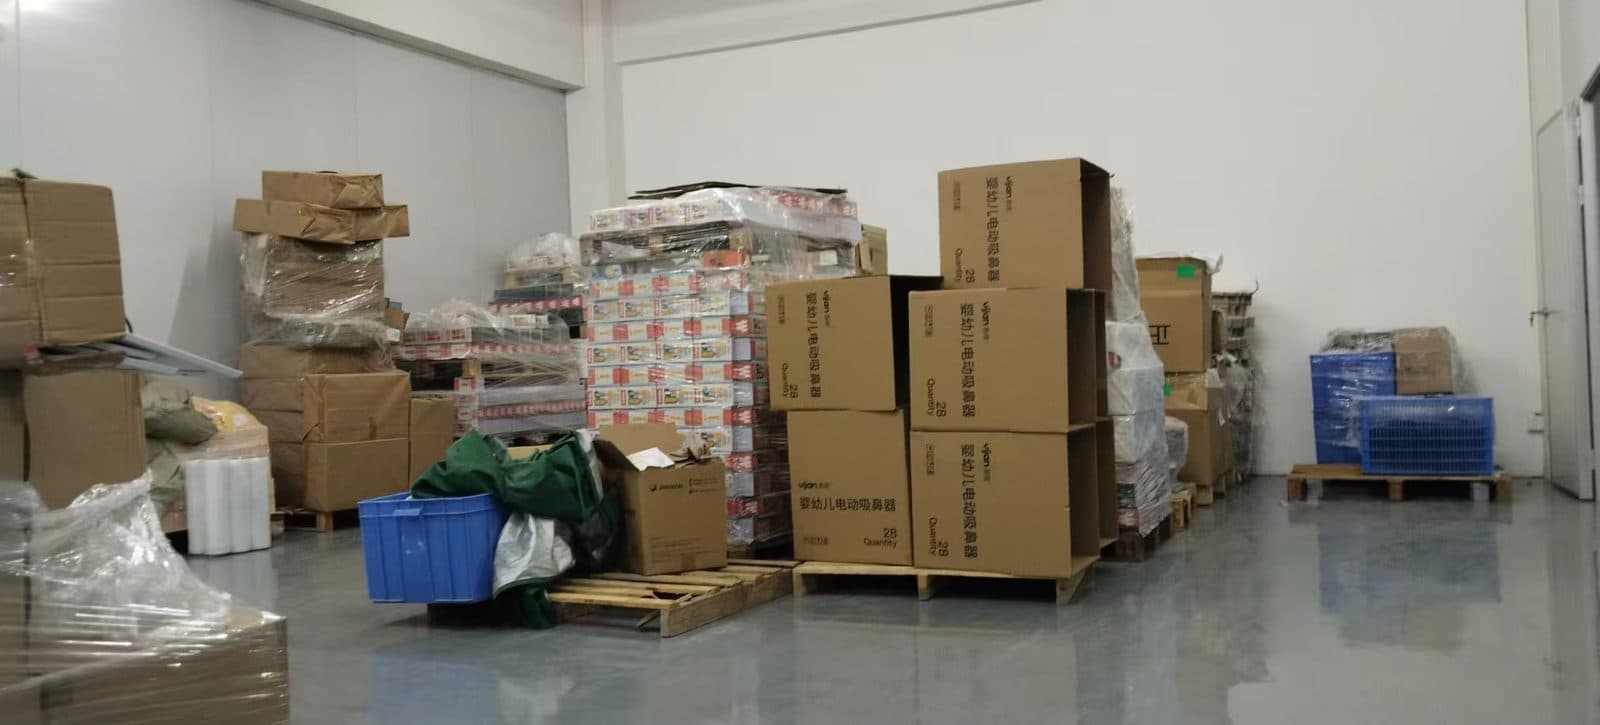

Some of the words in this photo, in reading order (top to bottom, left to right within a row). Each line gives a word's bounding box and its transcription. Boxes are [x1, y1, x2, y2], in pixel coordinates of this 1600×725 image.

[965, 269, 975, 283] 28
[806, 292, 821, 398] 婴幼儿电动吸鼻器
[960, 303, 976, 417] 婴幼儿电动吸鼻器
[781, 362, 790, 398] Quantity
[789, 384, 798, 399] 28
[926, 378, 936, 416] Quantity
[936, 401, 946, 417] 28
[799, 496, 896, 512] 婴幼儿电动吸鼻器
[961, 443, 978, 558] 婴幼儿电动吸鼻器
[883, 527, 897, 538] 28
[928, 517, 938, 555] Quantity
[863, 538, 897, 549] Quantity
[938, 541, 949, 557] 28
